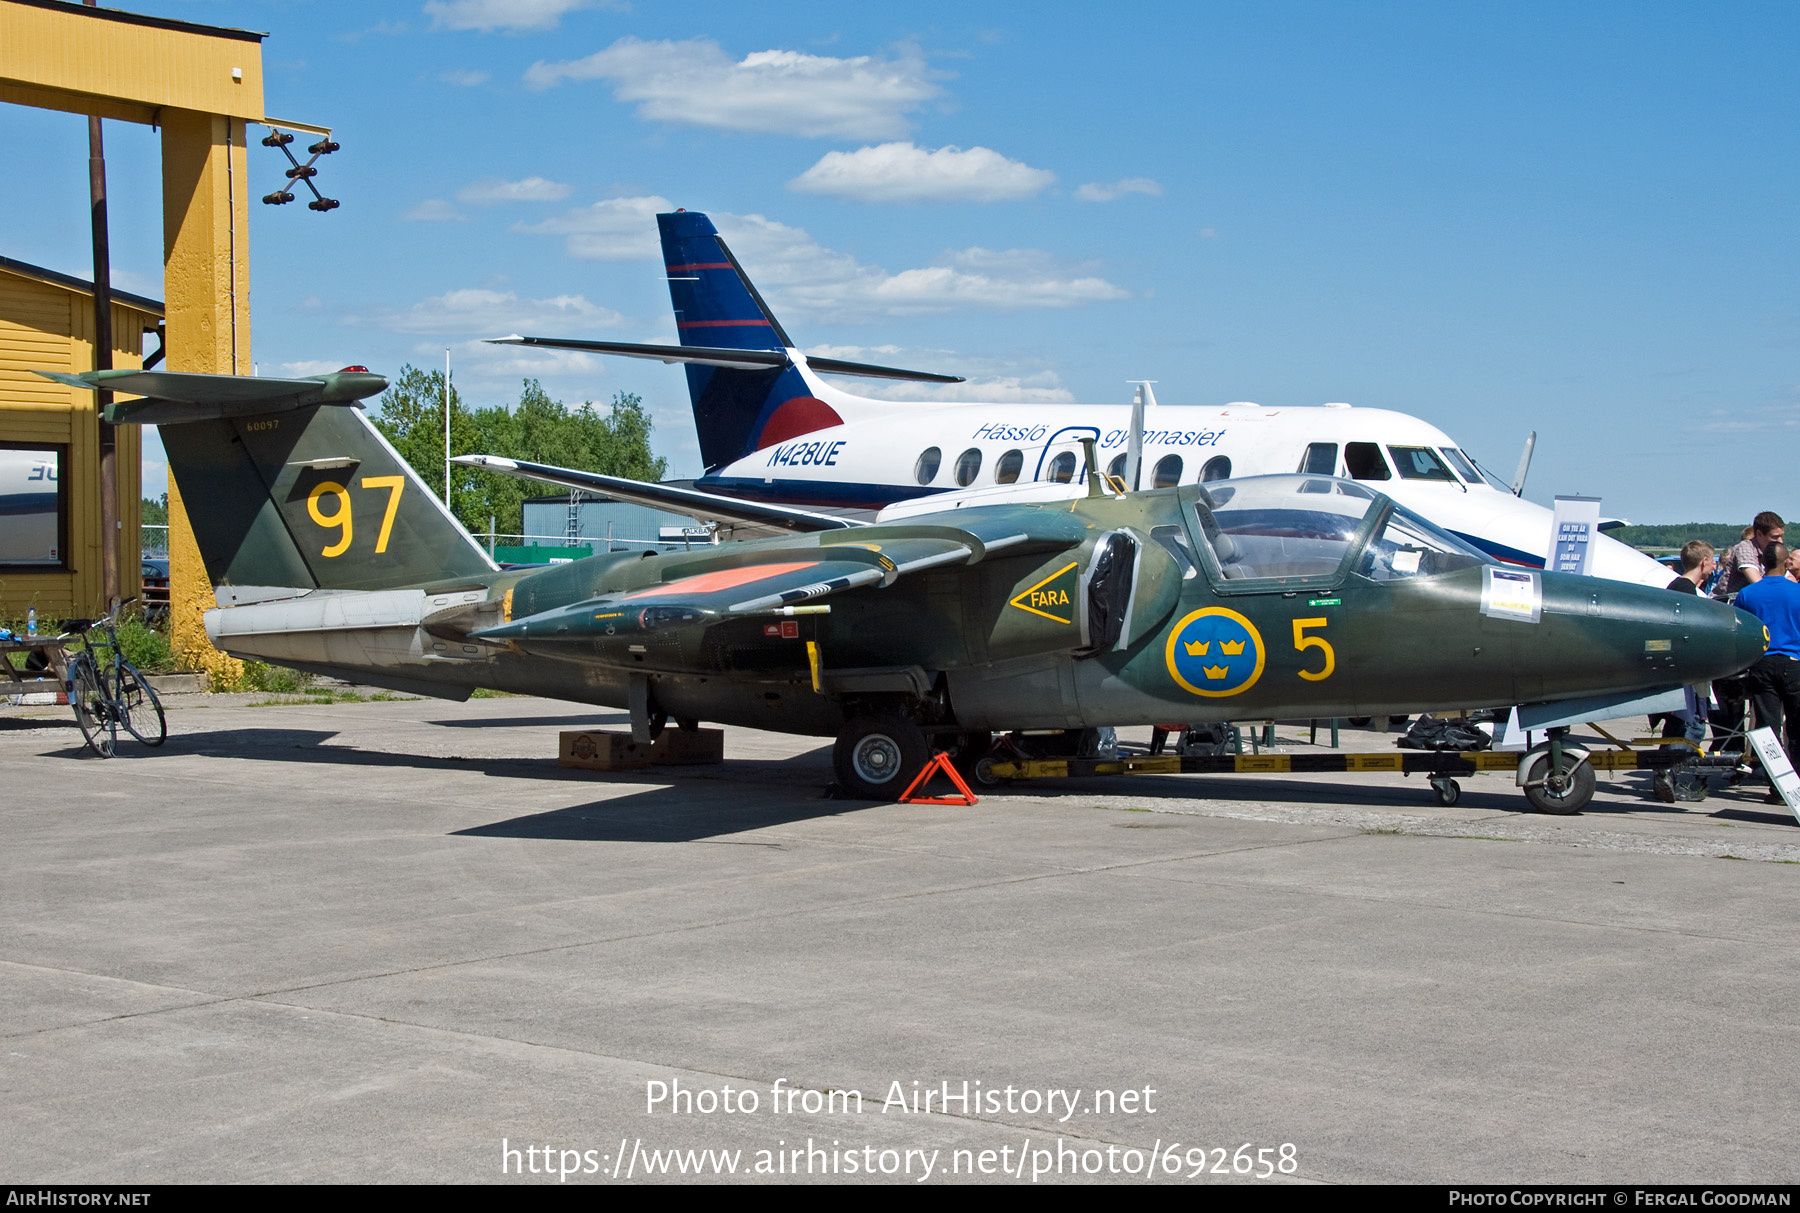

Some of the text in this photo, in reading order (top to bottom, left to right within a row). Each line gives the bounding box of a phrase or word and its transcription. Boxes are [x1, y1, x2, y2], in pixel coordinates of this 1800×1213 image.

[247, 419, 280, 431] 60097
[972, 423, 1050, 442] Hässlö
[1101, 428, 1227, 449] gymnasiet
[766, 440, 847, 467] N428UE
[306, 475, 405, 558] 97
[1031, 589, 1070, 608] FARA
[1292, 616, 1335, 681] 5
